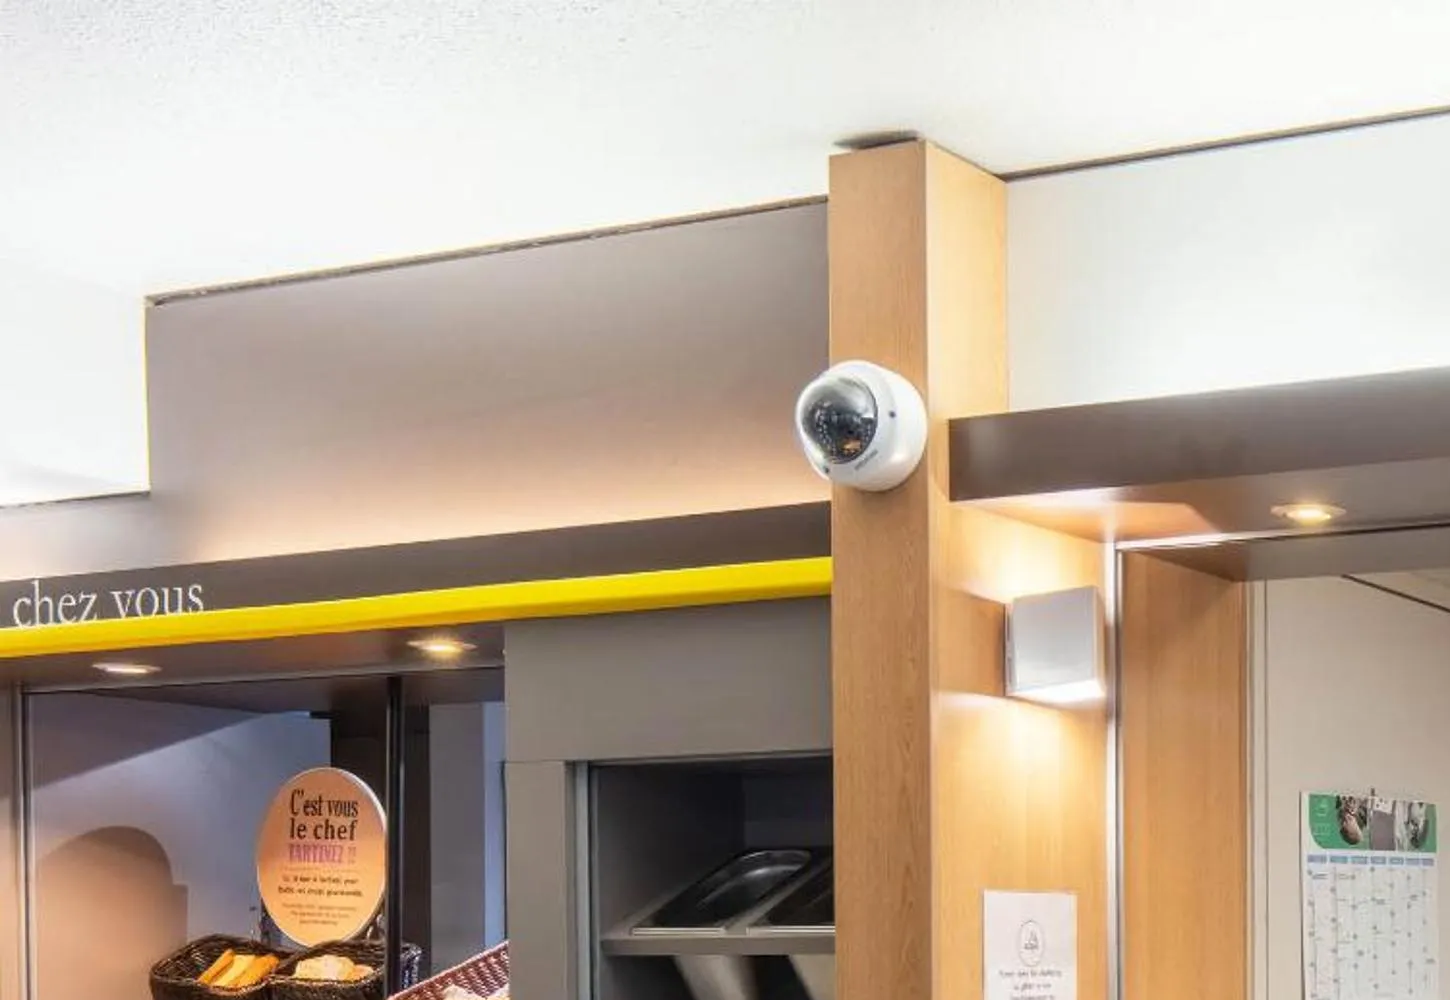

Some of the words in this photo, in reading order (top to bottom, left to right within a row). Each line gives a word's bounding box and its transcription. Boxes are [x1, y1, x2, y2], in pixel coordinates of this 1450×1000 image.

[12, 580, 99, 629] chez
[109, 583, 205, 620] vous
[289, 788, 323, 818] C'est
[327, 799, 359, 818] vous
[289, 818, 307, 840] le
[313, 818, 359, 842] chef
